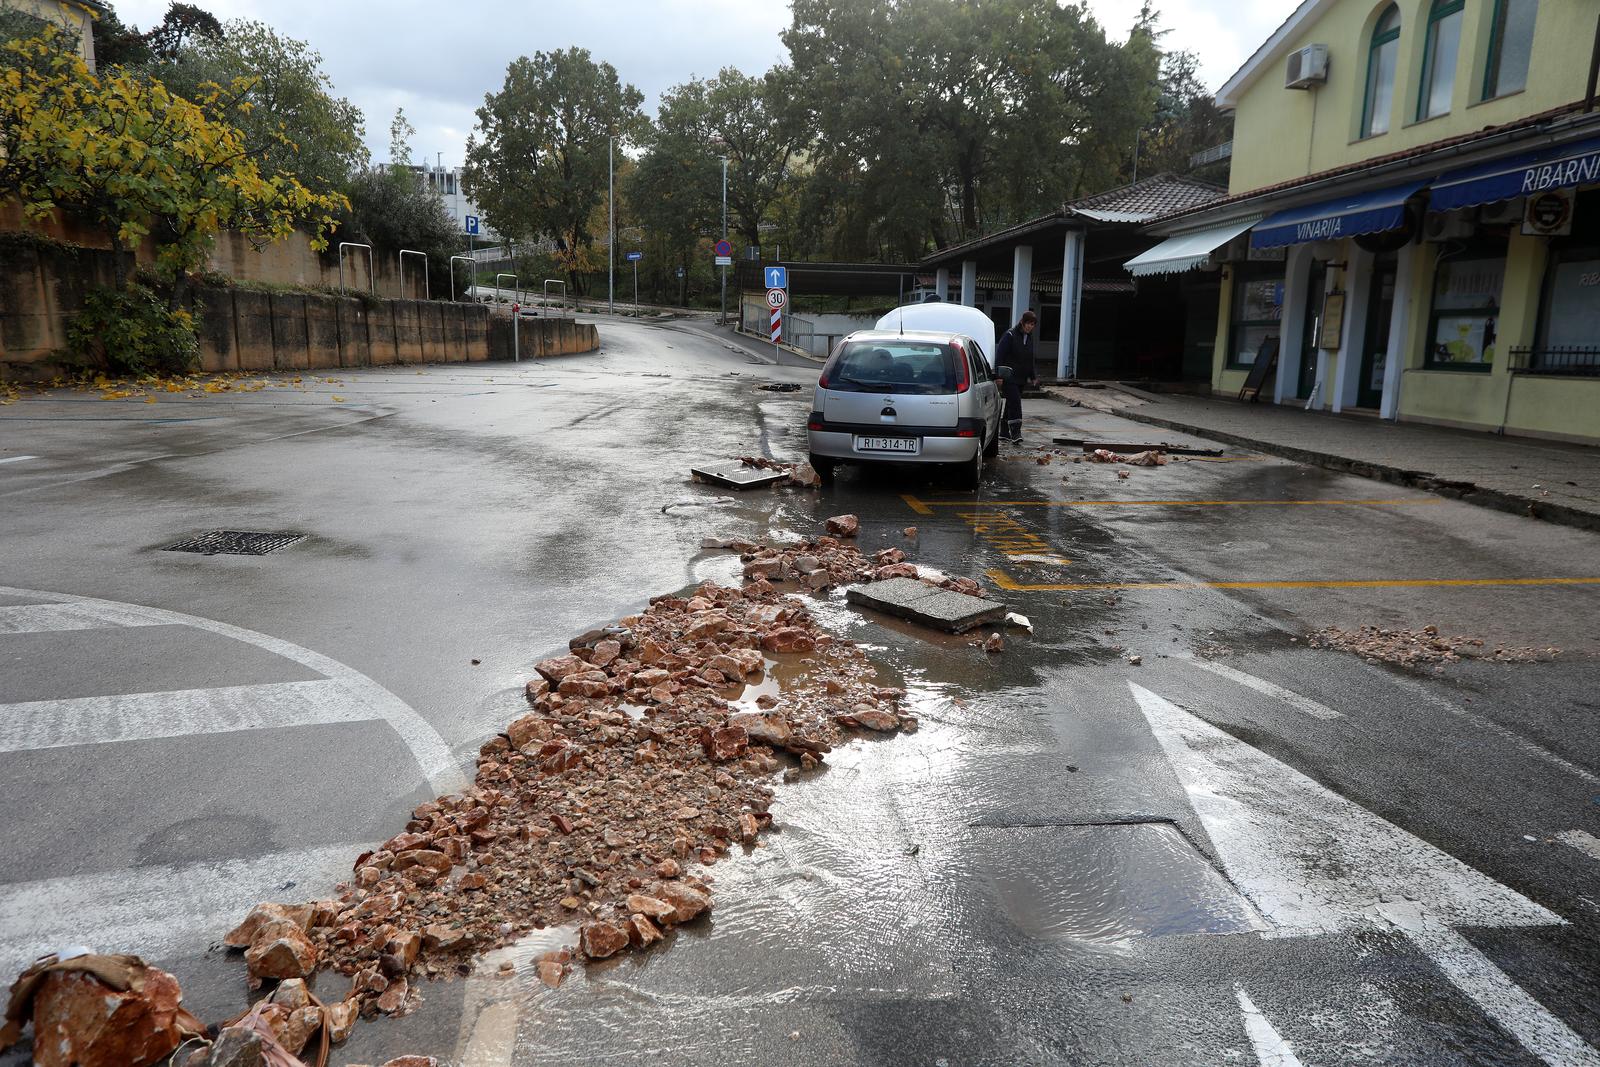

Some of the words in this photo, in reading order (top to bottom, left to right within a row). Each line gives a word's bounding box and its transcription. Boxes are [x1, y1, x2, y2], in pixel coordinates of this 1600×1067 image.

[468, 217, 476, 232] P
[1297, 217, 1341, 240] VINARIJA
[770, 292, 783, 304] 30
[864, 438, 874, 448] RI
[881, 438, 915, 450] 314-TR
